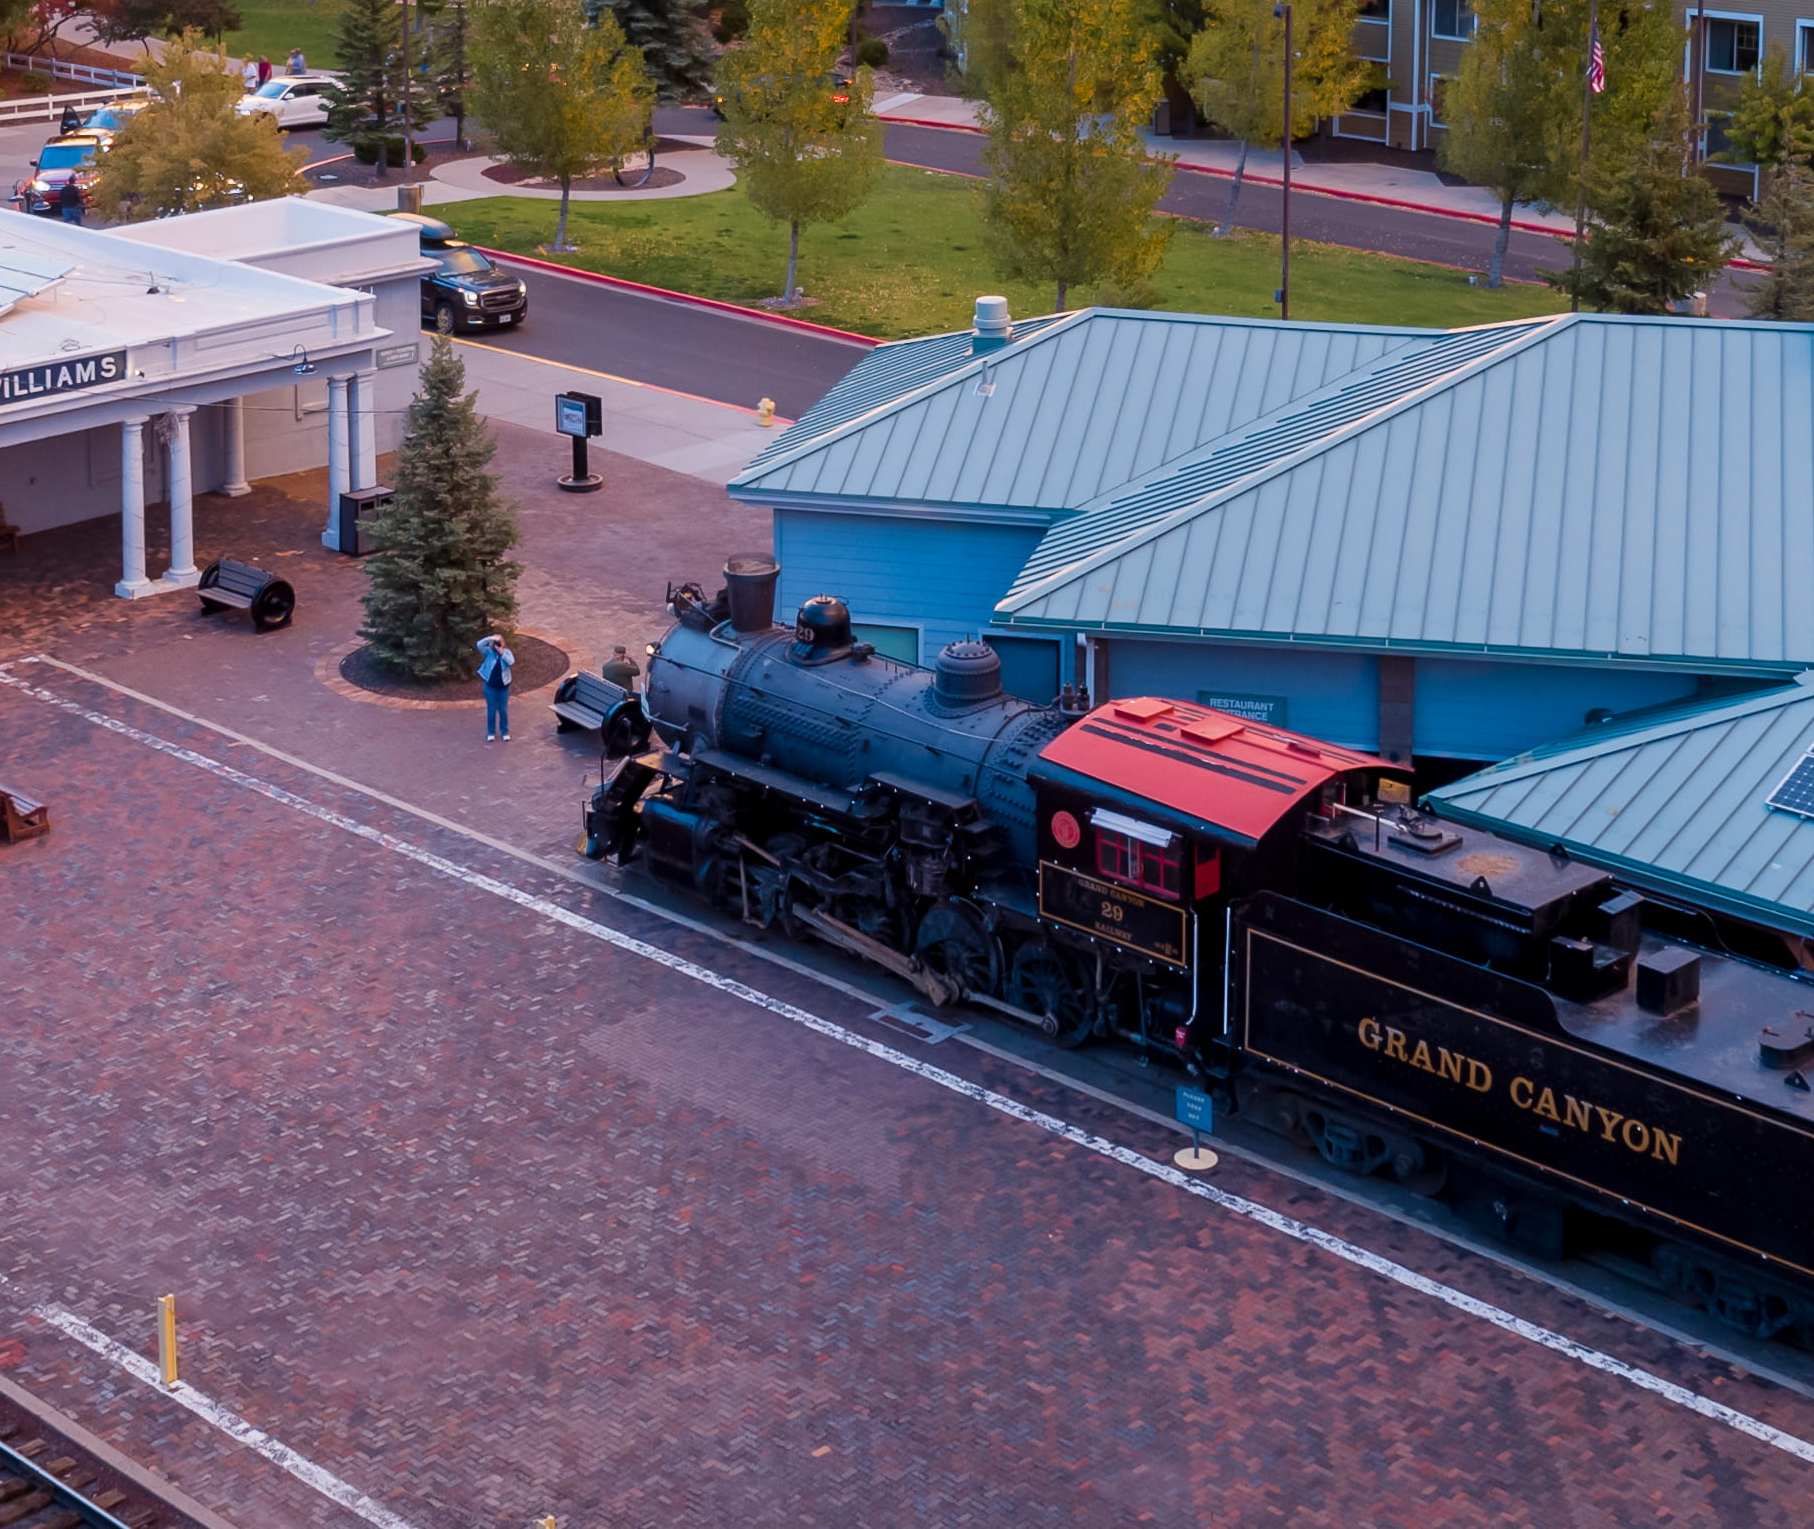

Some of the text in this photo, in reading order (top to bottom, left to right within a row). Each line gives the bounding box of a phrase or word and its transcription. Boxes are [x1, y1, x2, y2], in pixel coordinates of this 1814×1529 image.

[797, 624, 815, 642] 29
[1209, 698, 1274, 712] RESTAURANT
[1216, 709, 1268, 721] RANCE
[1078, 878, 1146, 908] GRAND CANYON
[1101, 901, 1124, 921] 29
[1095, 921, 1132, 941] RAILWAY
[1358, 1017, 1683, 1166] GRAND CANYON
